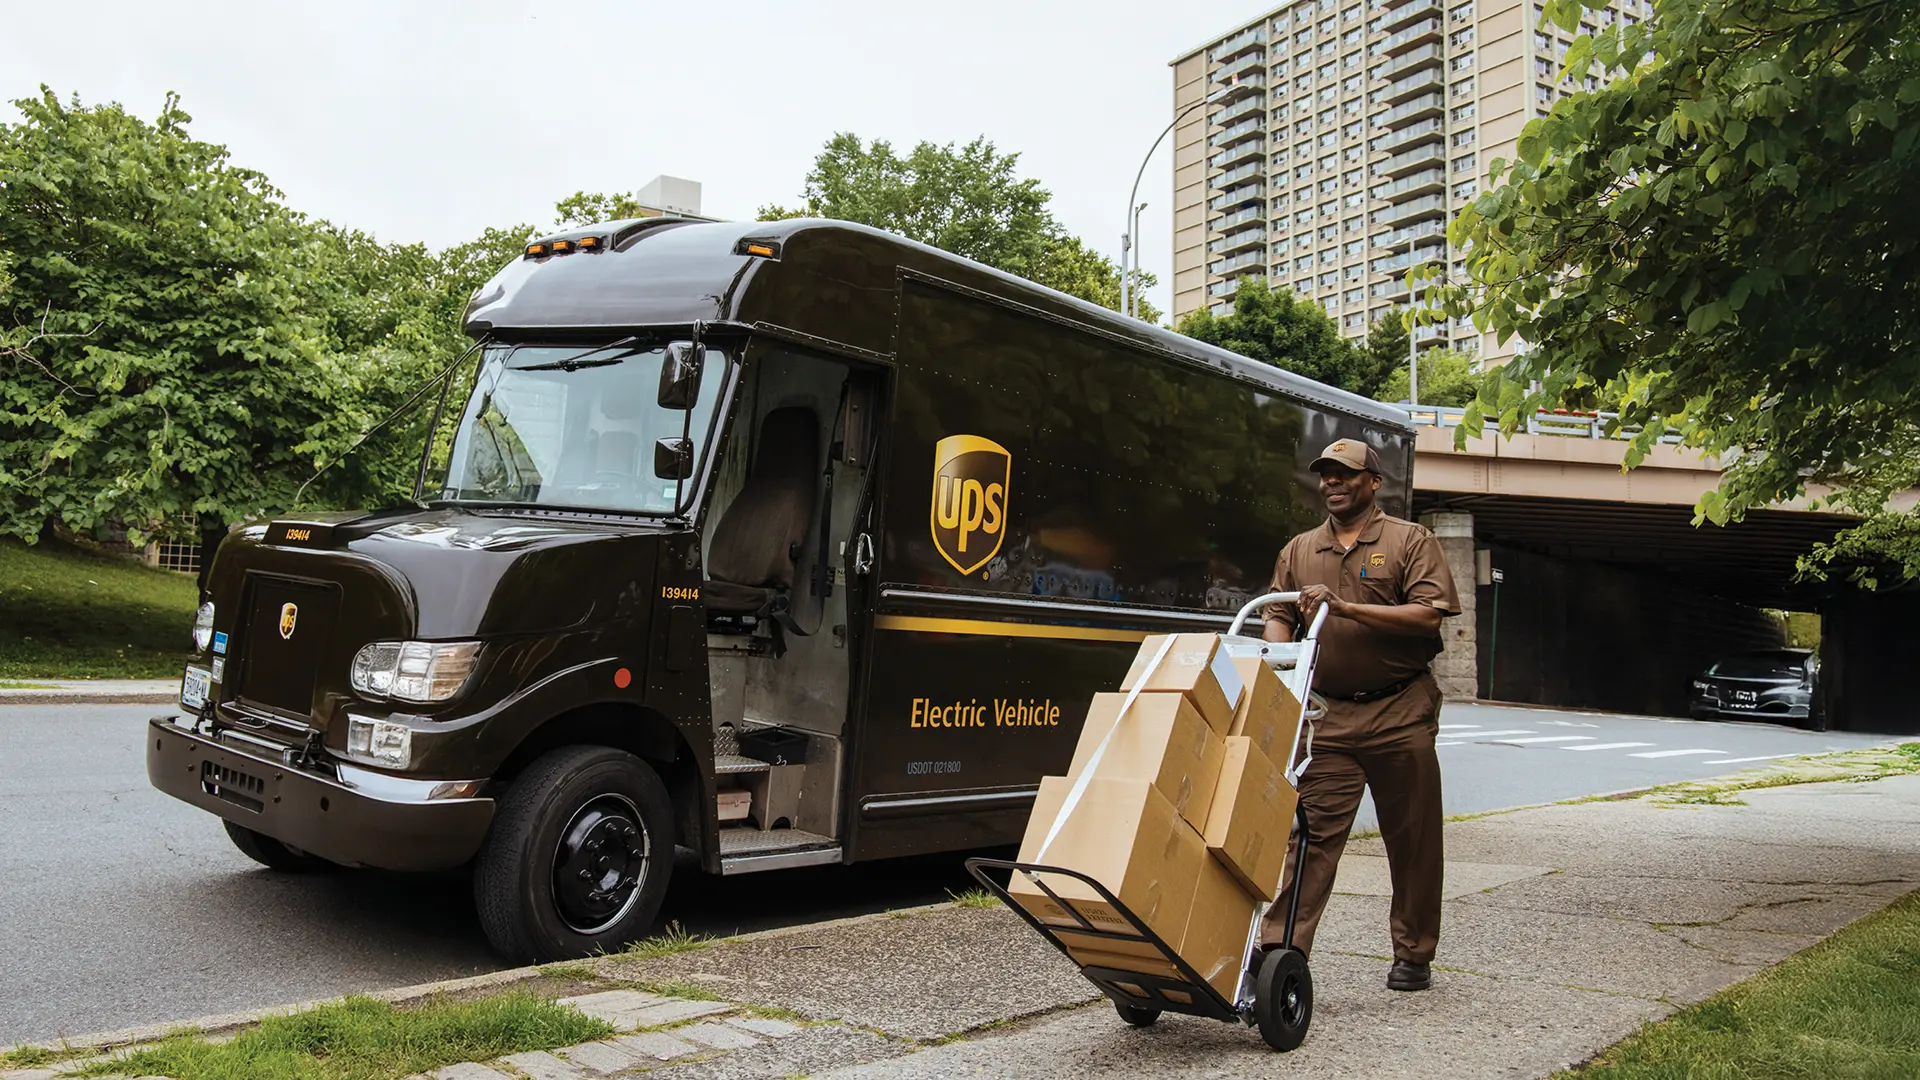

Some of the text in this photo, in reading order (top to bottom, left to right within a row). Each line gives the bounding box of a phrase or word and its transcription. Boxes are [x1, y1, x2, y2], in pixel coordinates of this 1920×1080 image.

[937, 475, 1003, 552] ups
[286, 529, 310, 540] 139414
[1371, 557, 1385, 566] ups
[662, 586, 699, 600] 139414
[282, 614, 295, 632] ups
[911, 698, 1060, 728] Electric Vehicle
[907, 761, 961, 775] USDOT 021800
